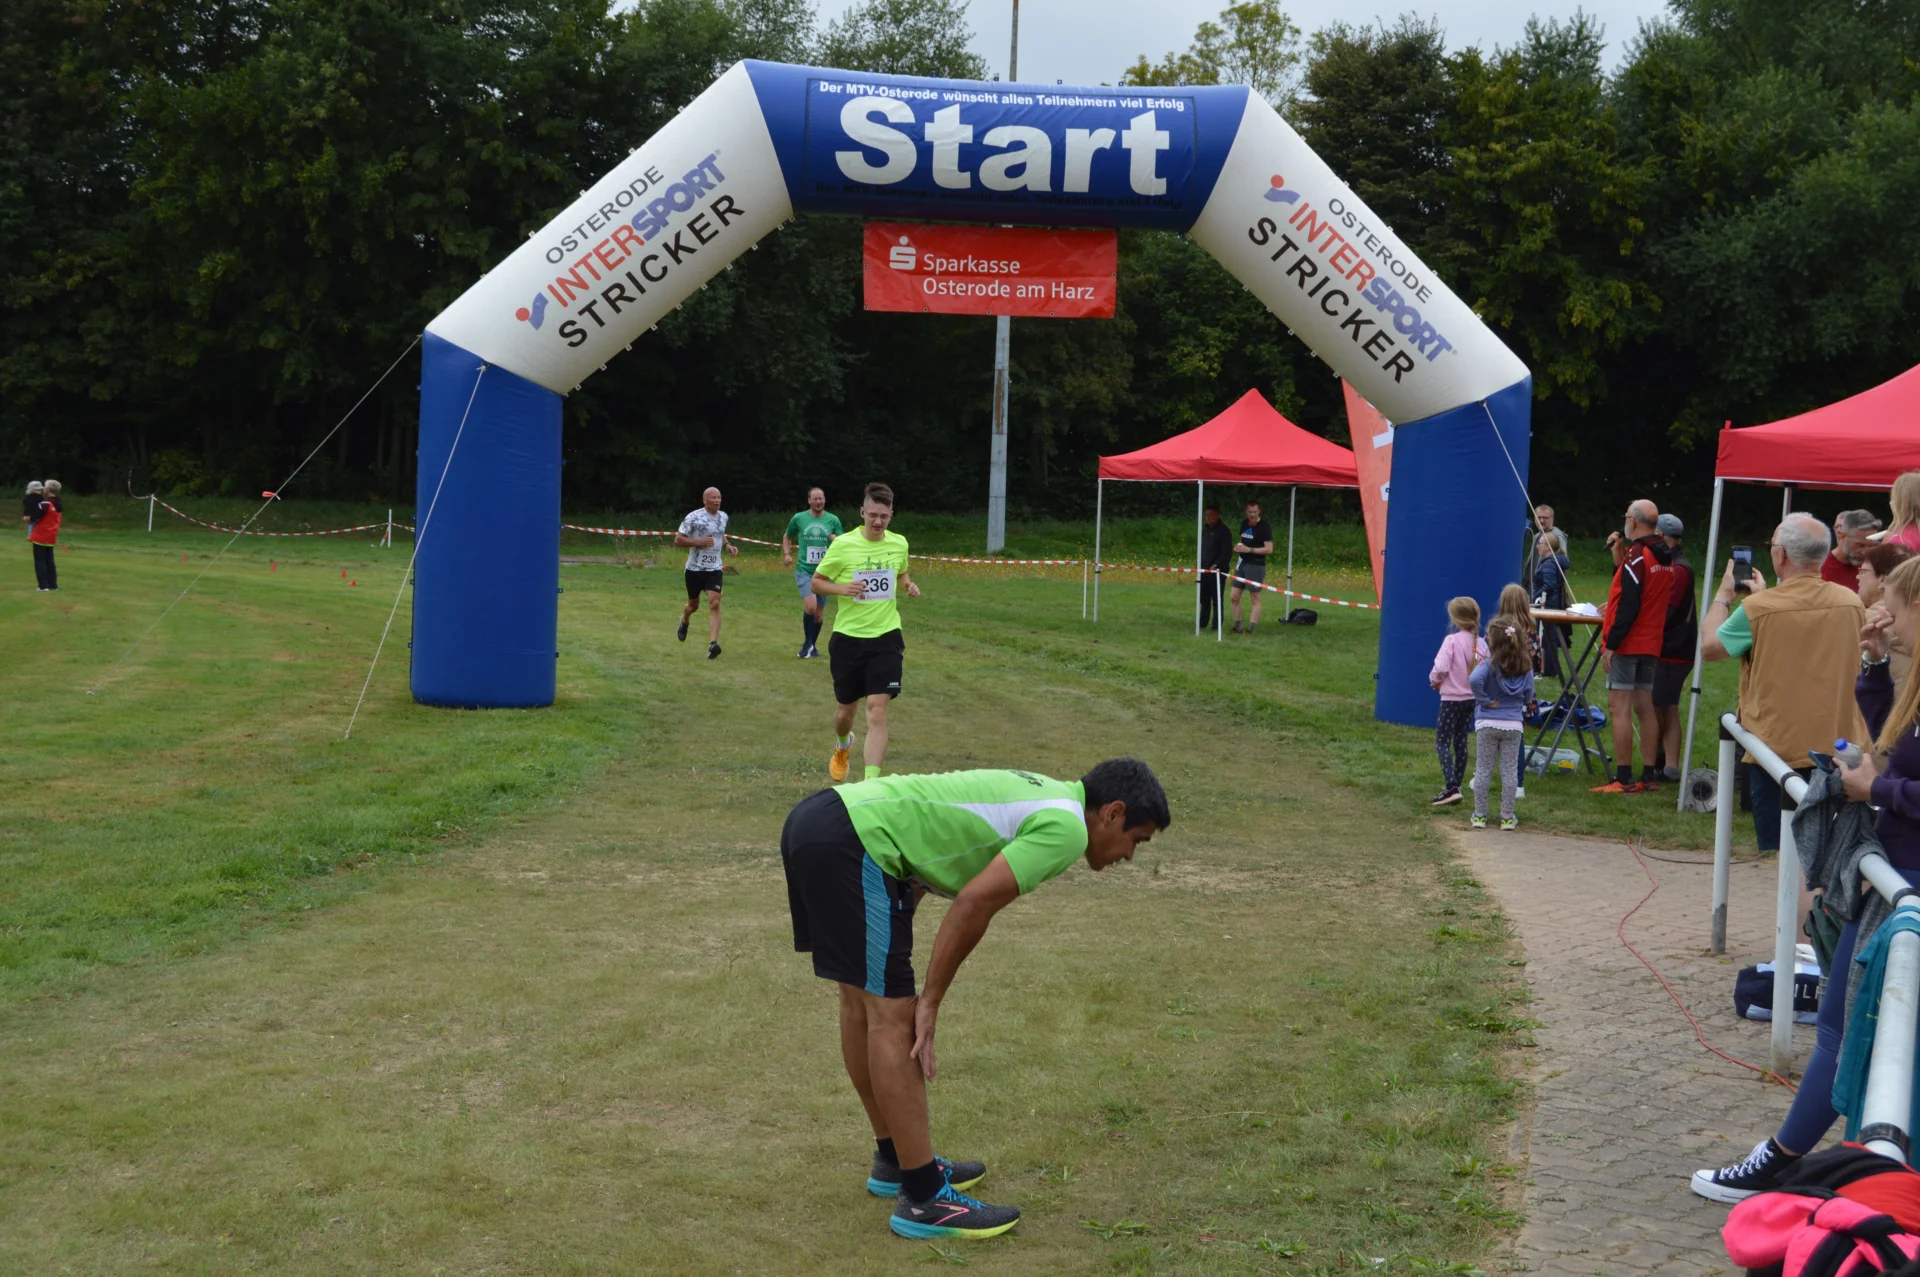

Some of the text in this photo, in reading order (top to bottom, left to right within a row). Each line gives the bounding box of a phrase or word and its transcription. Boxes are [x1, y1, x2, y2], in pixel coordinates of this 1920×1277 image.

[819, 81, 1185, 112] Der MTV-Osterode wünscht allen Teilnehmern viel Erfolg
[835, 96, 1170, 196] Start
[545, 165, 664, 264] OSTERODE
[923, 254, 1021, 274] Sparkasse
[1328, 198, 1432, 303] OSTERODE
[558, 194, 746, 348] STRICKER
[923, 277, 1095, 300] Osterode am Harz
[1248, 217, 1415, 384] STRICKER
[702, 555, 717, 563] 230
